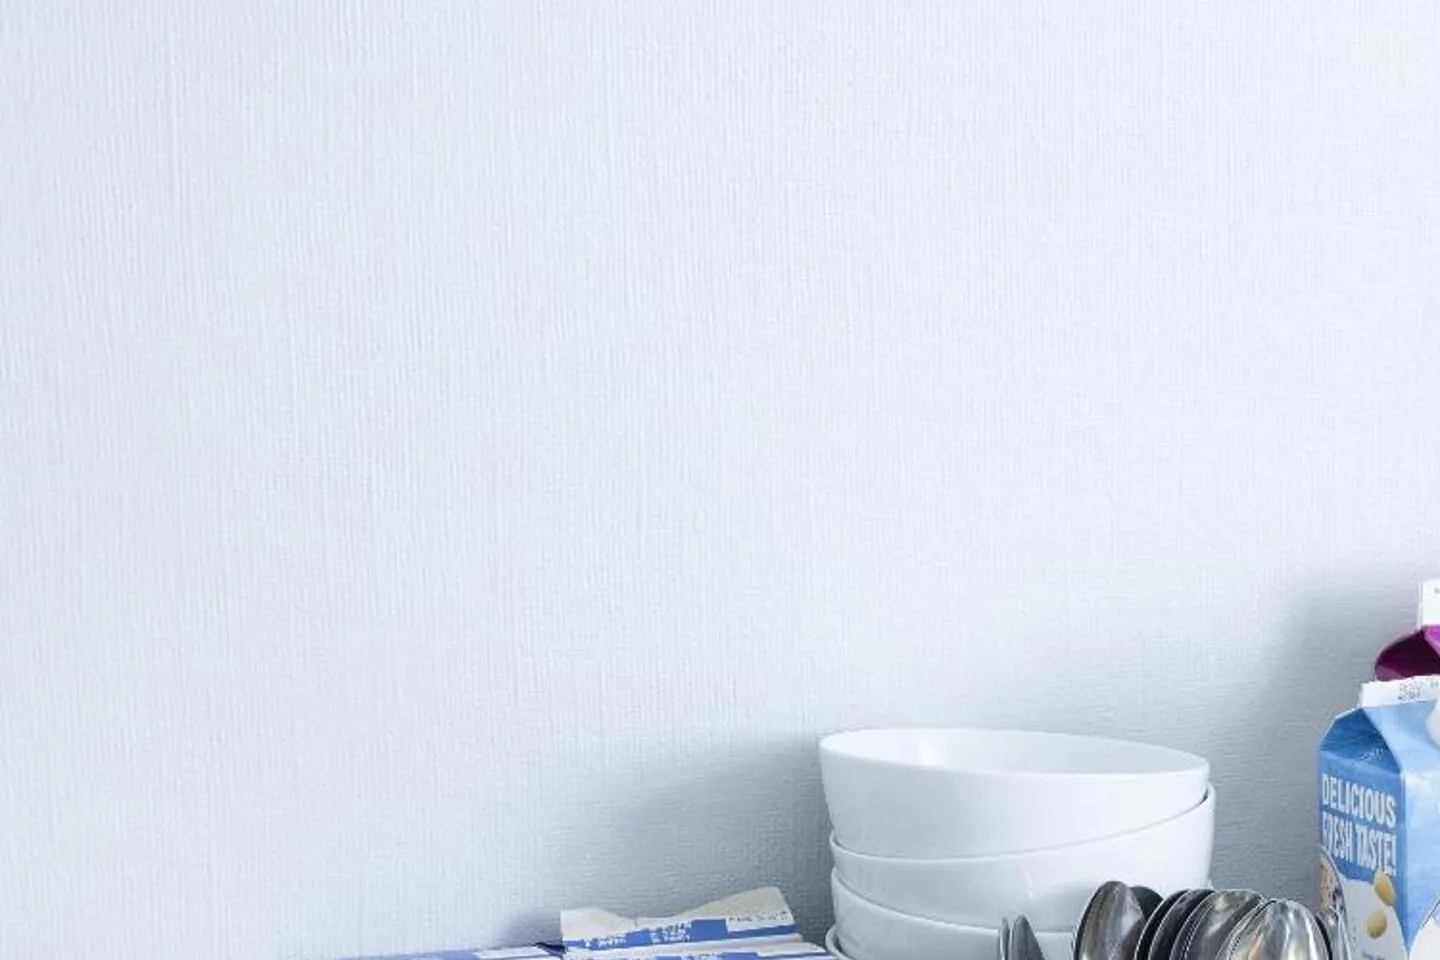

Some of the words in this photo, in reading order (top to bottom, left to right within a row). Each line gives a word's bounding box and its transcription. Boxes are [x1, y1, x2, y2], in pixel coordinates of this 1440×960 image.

[1322, 773, 1396, 828] DELICIOUS
[1322, 811, 1353, 863] FRESH
[1355, 823, 1396, 876] TASTE!
